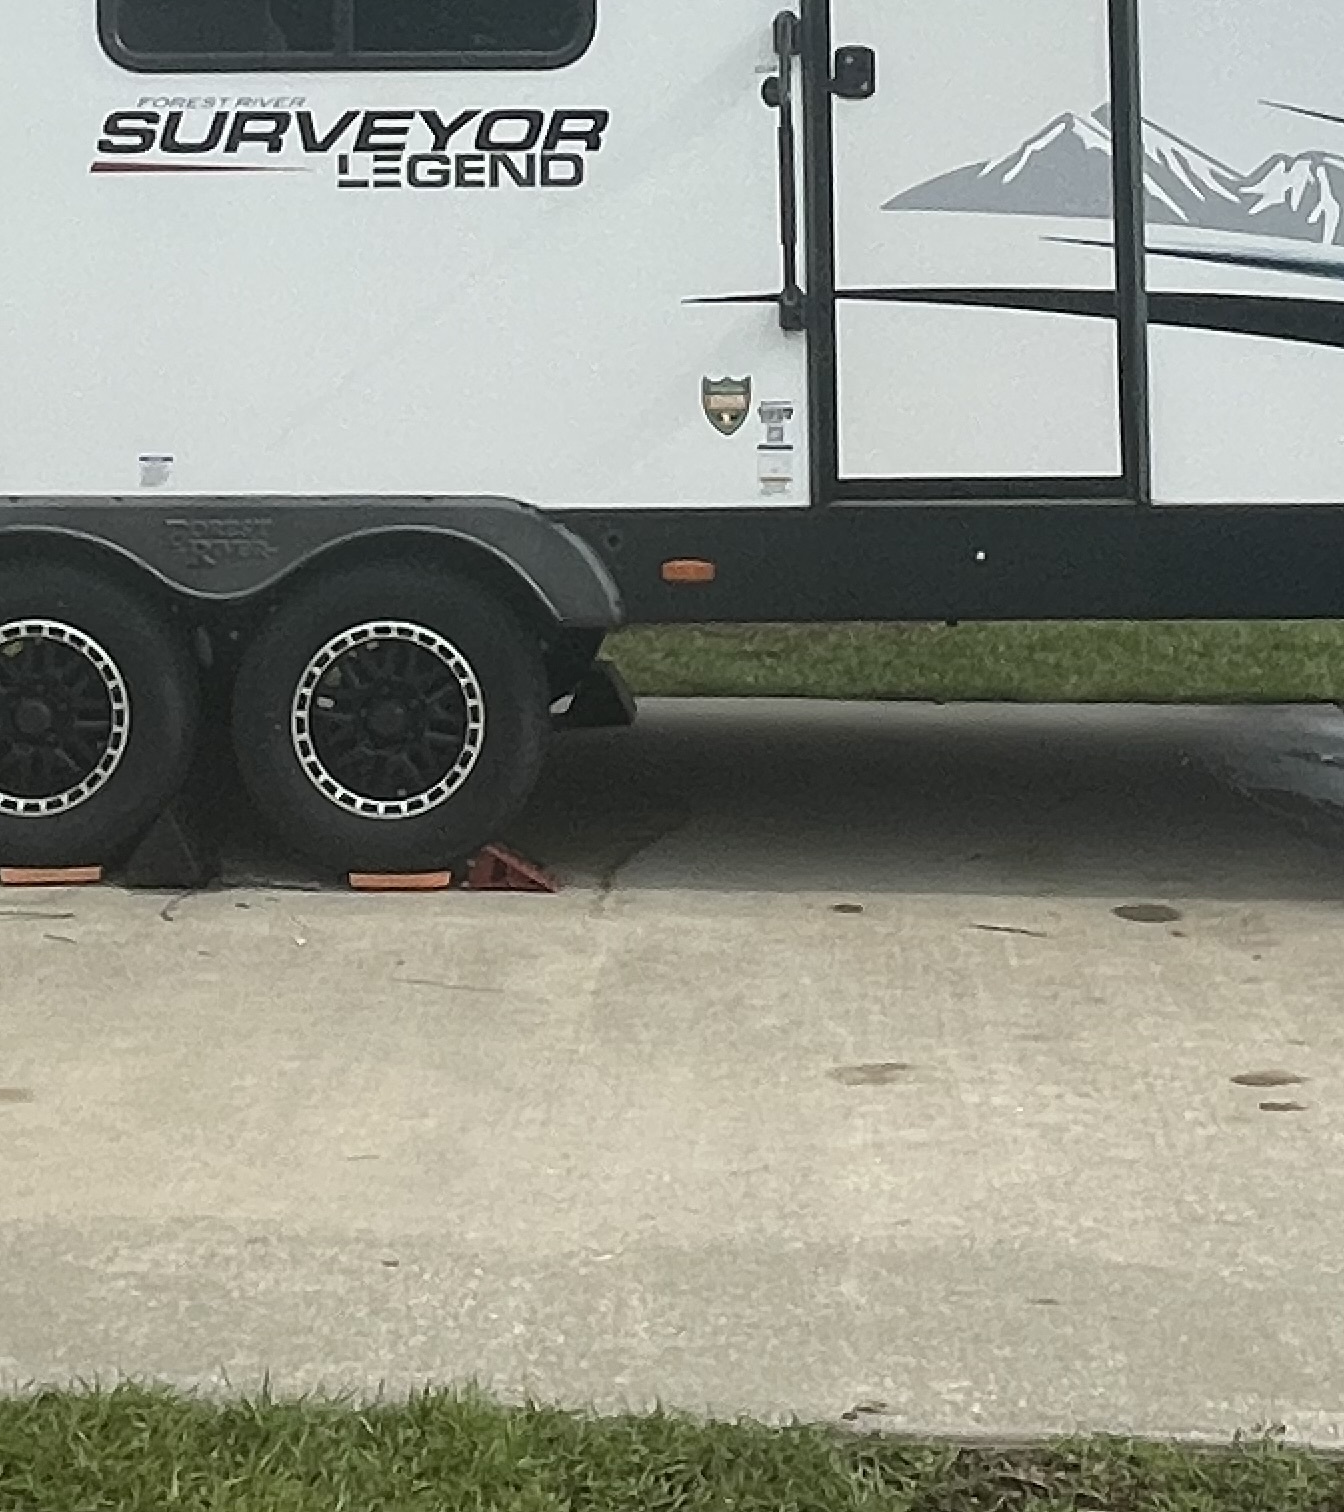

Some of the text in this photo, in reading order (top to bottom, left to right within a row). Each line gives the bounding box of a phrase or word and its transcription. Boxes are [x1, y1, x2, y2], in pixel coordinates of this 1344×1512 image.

[137, 96, 307, 108] FOREST RIVER
[96, 108, 610, 154] SURVEYOR
[337, 153, 584, 188] LEGEND
